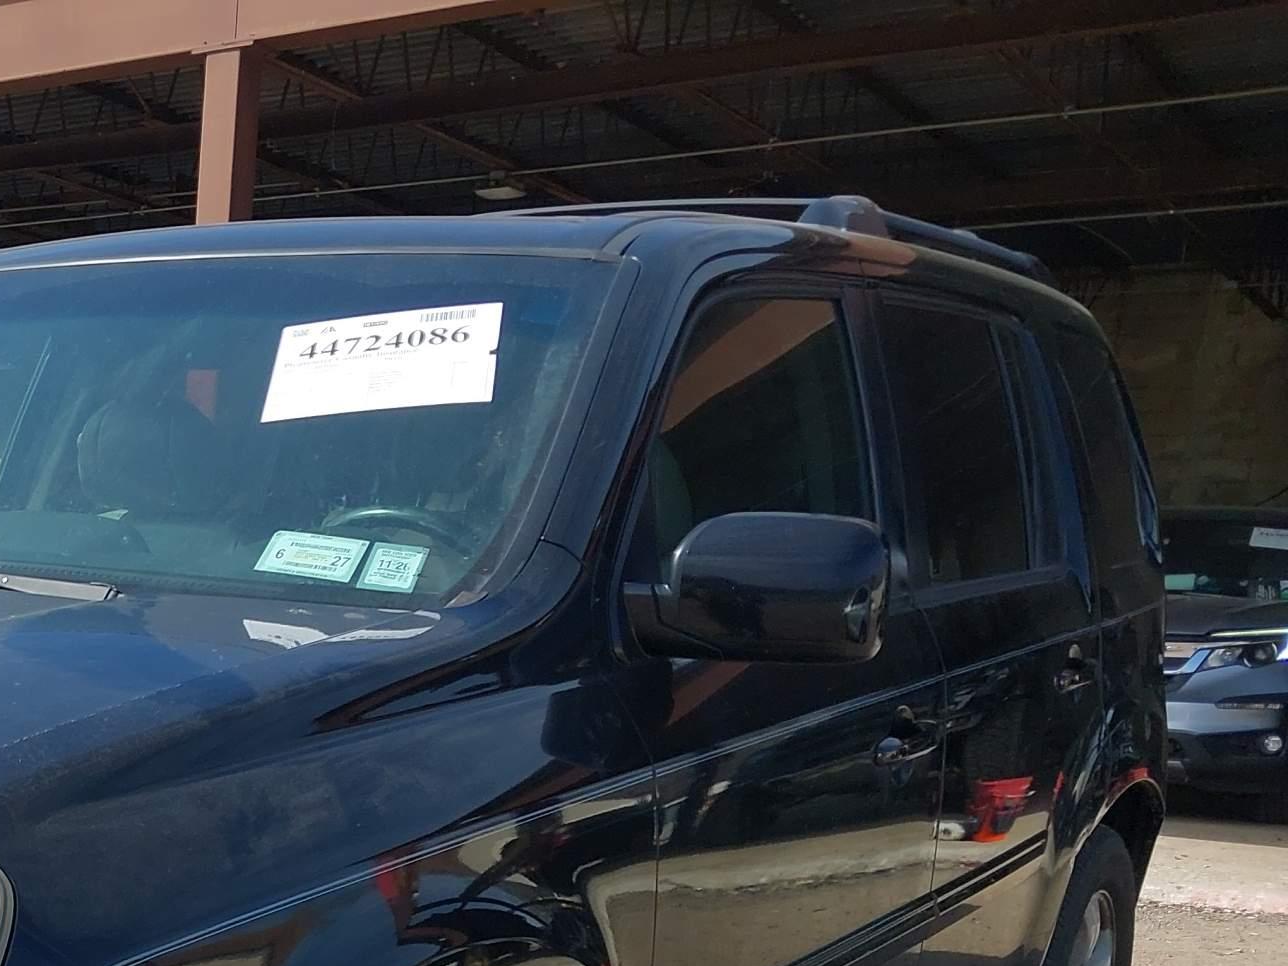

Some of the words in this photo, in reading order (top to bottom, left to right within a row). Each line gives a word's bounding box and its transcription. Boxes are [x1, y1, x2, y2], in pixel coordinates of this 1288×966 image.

[299, 325, 472, 360] 44724086
[275, 548, 286, 559] 6
[330, 555, 352, 568] 27
